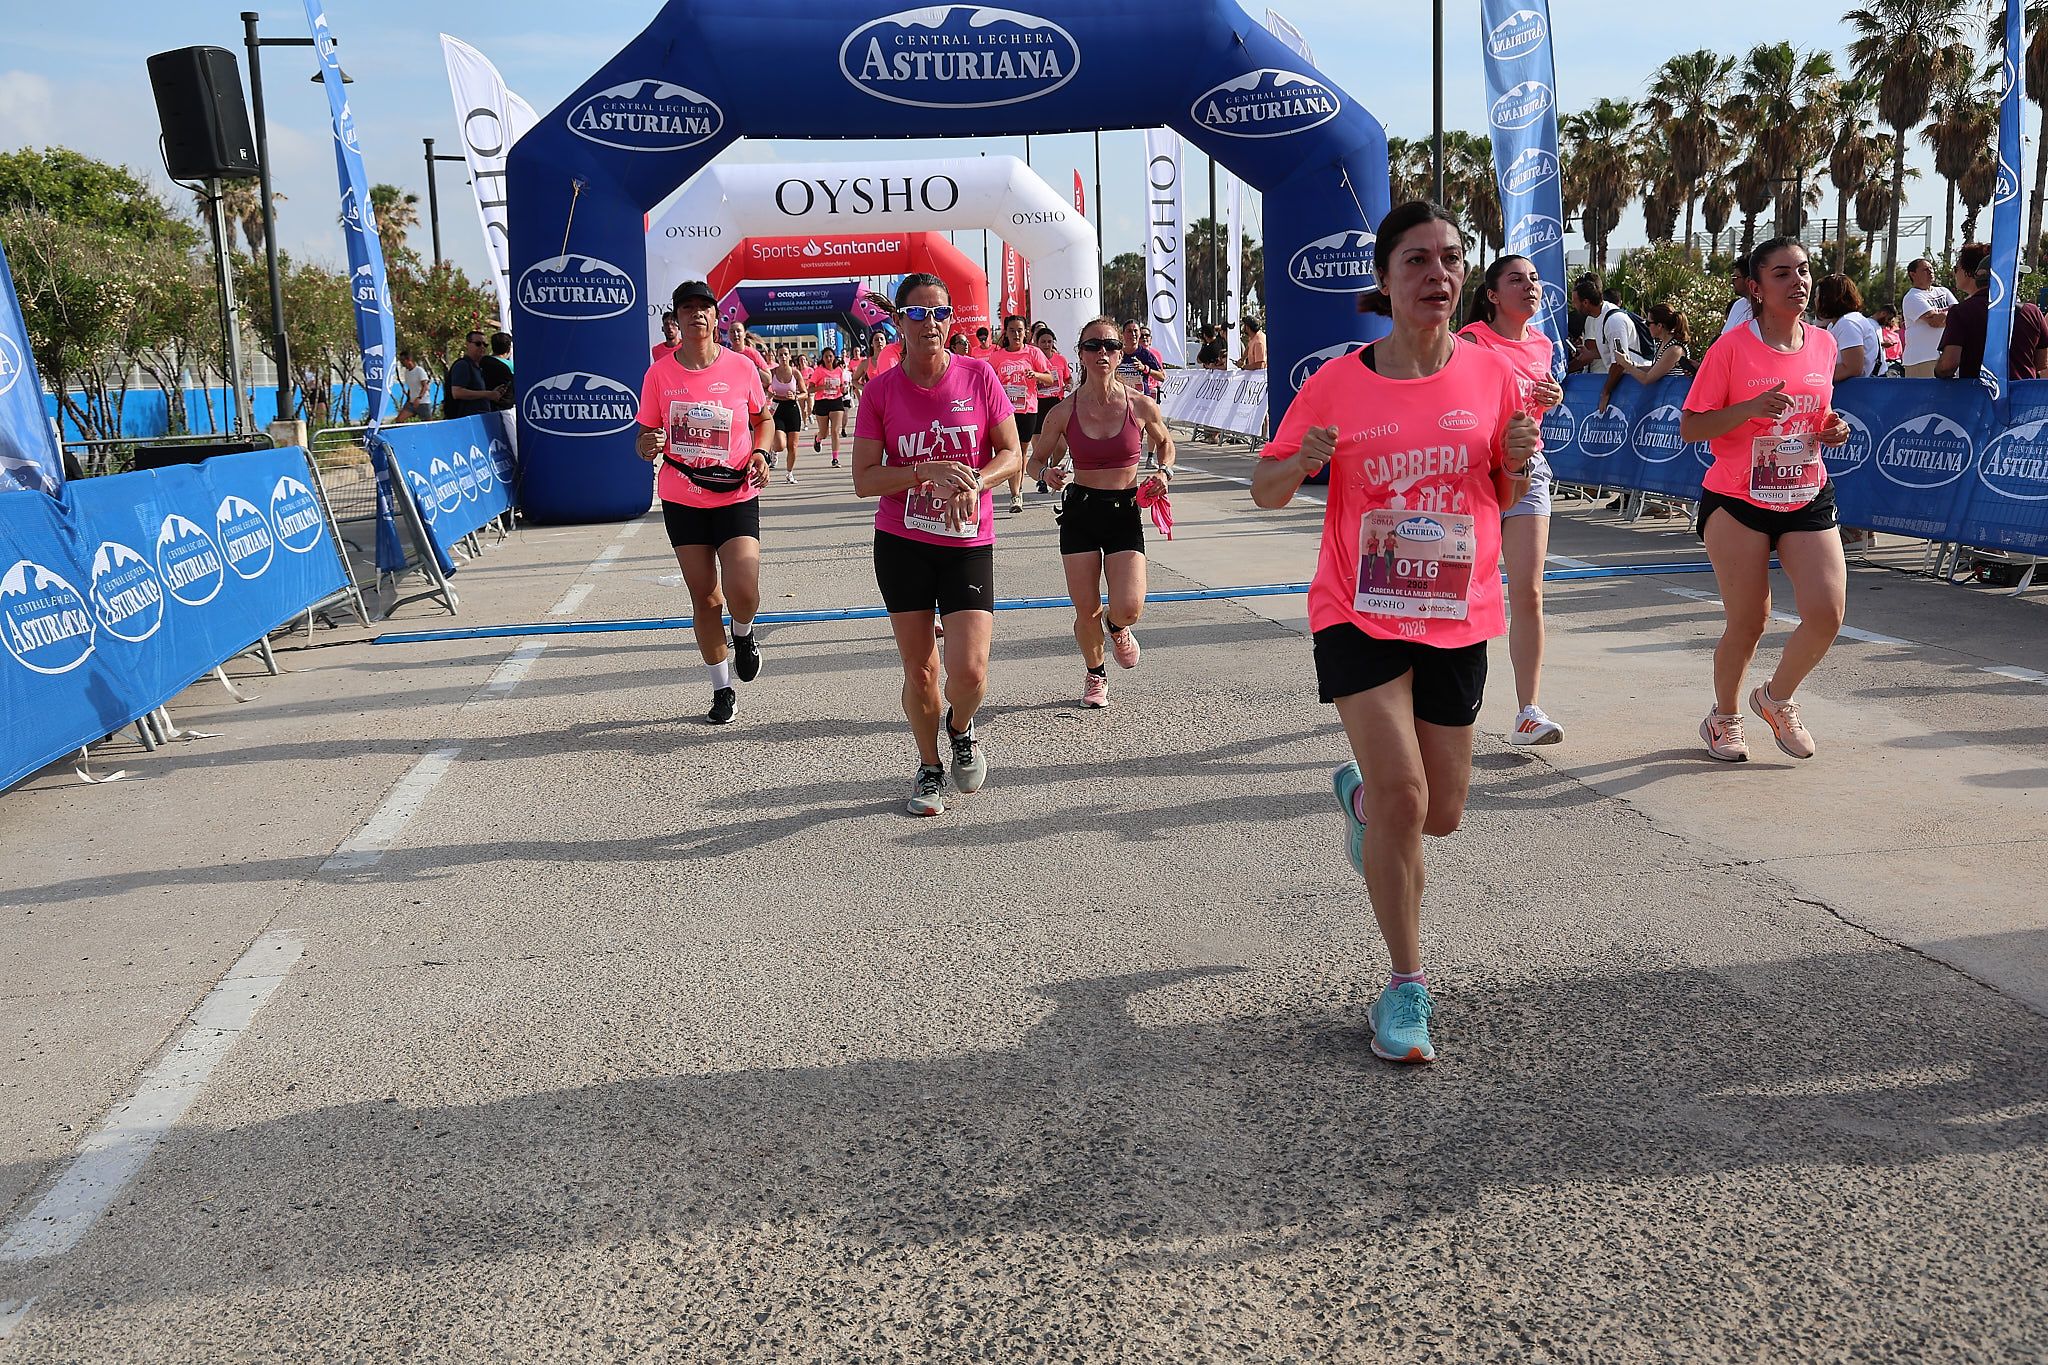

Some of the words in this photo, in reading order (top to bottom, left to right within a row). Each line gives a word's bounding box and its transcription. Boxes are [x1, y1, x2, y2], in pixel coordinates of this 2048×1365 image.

[895, 34, 970, 46] CENTRAL
[978, 33, 1054, 44] LECHERA
[858, 36, 1063, 81] ASTURIANA
[1225, 92, 1276, 104] CENTRAL
[1280, 88, 1323, 97] LECHERA
[602, 102, 654, 111] CENTRAL
[659, 104, 709, 114] LECHERA
[1203, 96, 1334, 124] ASTURIANA
[577, 105, 712, 134] ASTURIANA
[775, 174, 959, 216] OYSHO
[1012, 211, 1065, 225] OYSHO
[665, 225, 721, 238] OYSHO
[752, 243, 801, 261] Sports
[823, 239, 901, 256] Santander
[1315, 251, 1357, 260] CENTRAL
[1297, 256, 1374, 280] ASTURIA
[537, 276, 581, 284] CENTRAL
[584, 277, 625, 285] LECHERA
[523, 279, 629, 304] ASTURIANA
[777, 291, 806, 299] octopus
[805, 290, 830, 298] energy
[1043, 287, 1093, 300] OYSHO
[957, 304, 979, 313] Sports
[1747, 377, 1780, 388] OYSHO
[664, 388, 689, 396] OYSHO
[529, 395, 634, 420] ASTURIANA
[688, 428, 711, 438] 016
[1352, 422, 1399, 443] OYSHO
[1900, 438, 1932, 447] CENTRAL
[1881, 438, 1963, 472] ASTURIANA
[1363, 444, 1469, 486] CARRERA
[1777, 465, 1803, 478] 016
[1371, 518, 1395, 527] SOMA
[1396, 559, 1440, 579] 016
[1368, 586, 1395, 595] CARRERA
[1407, 580, 1428, 590] 2905
[1368, 599, 1405, 610] OYSHO
[1398, 620, 1427, 637] 2026
